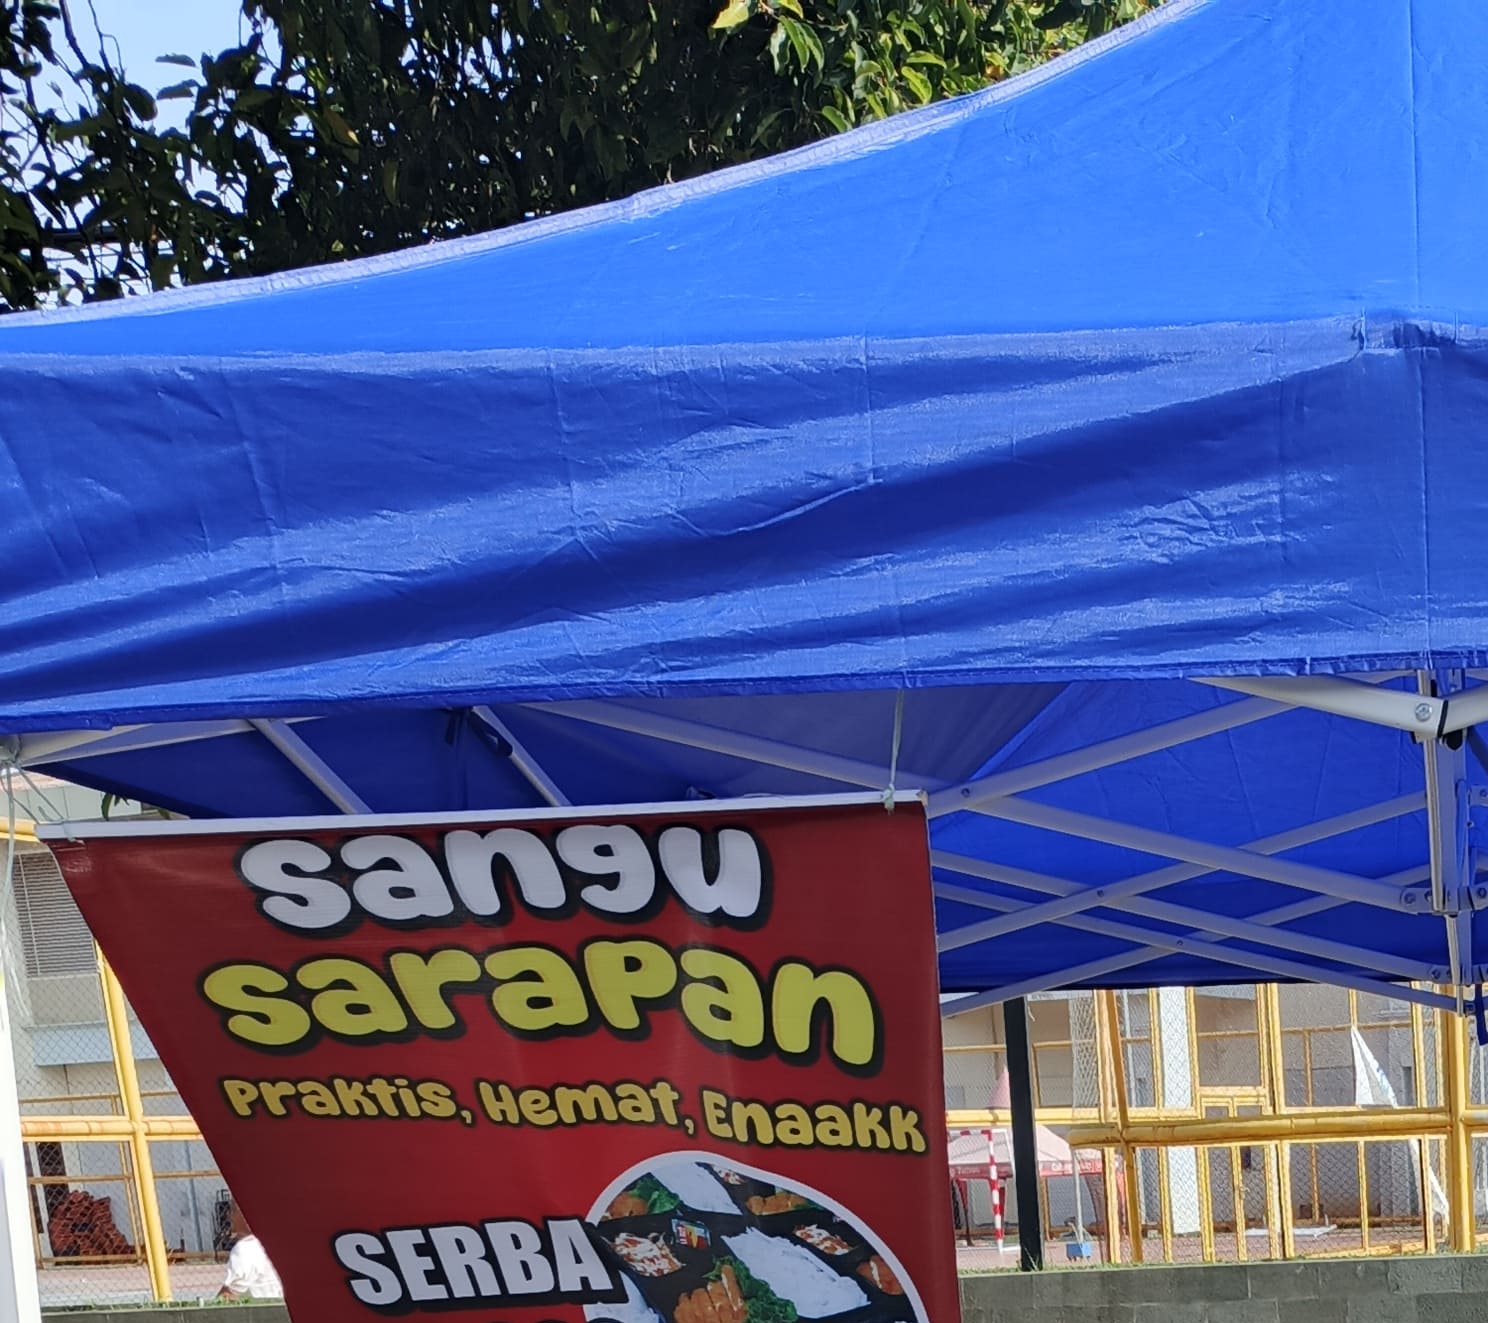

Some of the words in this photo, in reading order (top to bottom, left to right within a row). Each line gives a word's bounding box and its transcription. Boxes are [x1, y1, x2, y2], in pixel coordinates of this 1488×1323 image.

[239, 823, 766, 930] sangu
[222, 1076, 473, 1128] Praktis,
[478, 1079, 696, 1137] Hemat,
[702, 1089, 928, 1154] Enaakk
[334, 1218, 614, 1306] SERBA
